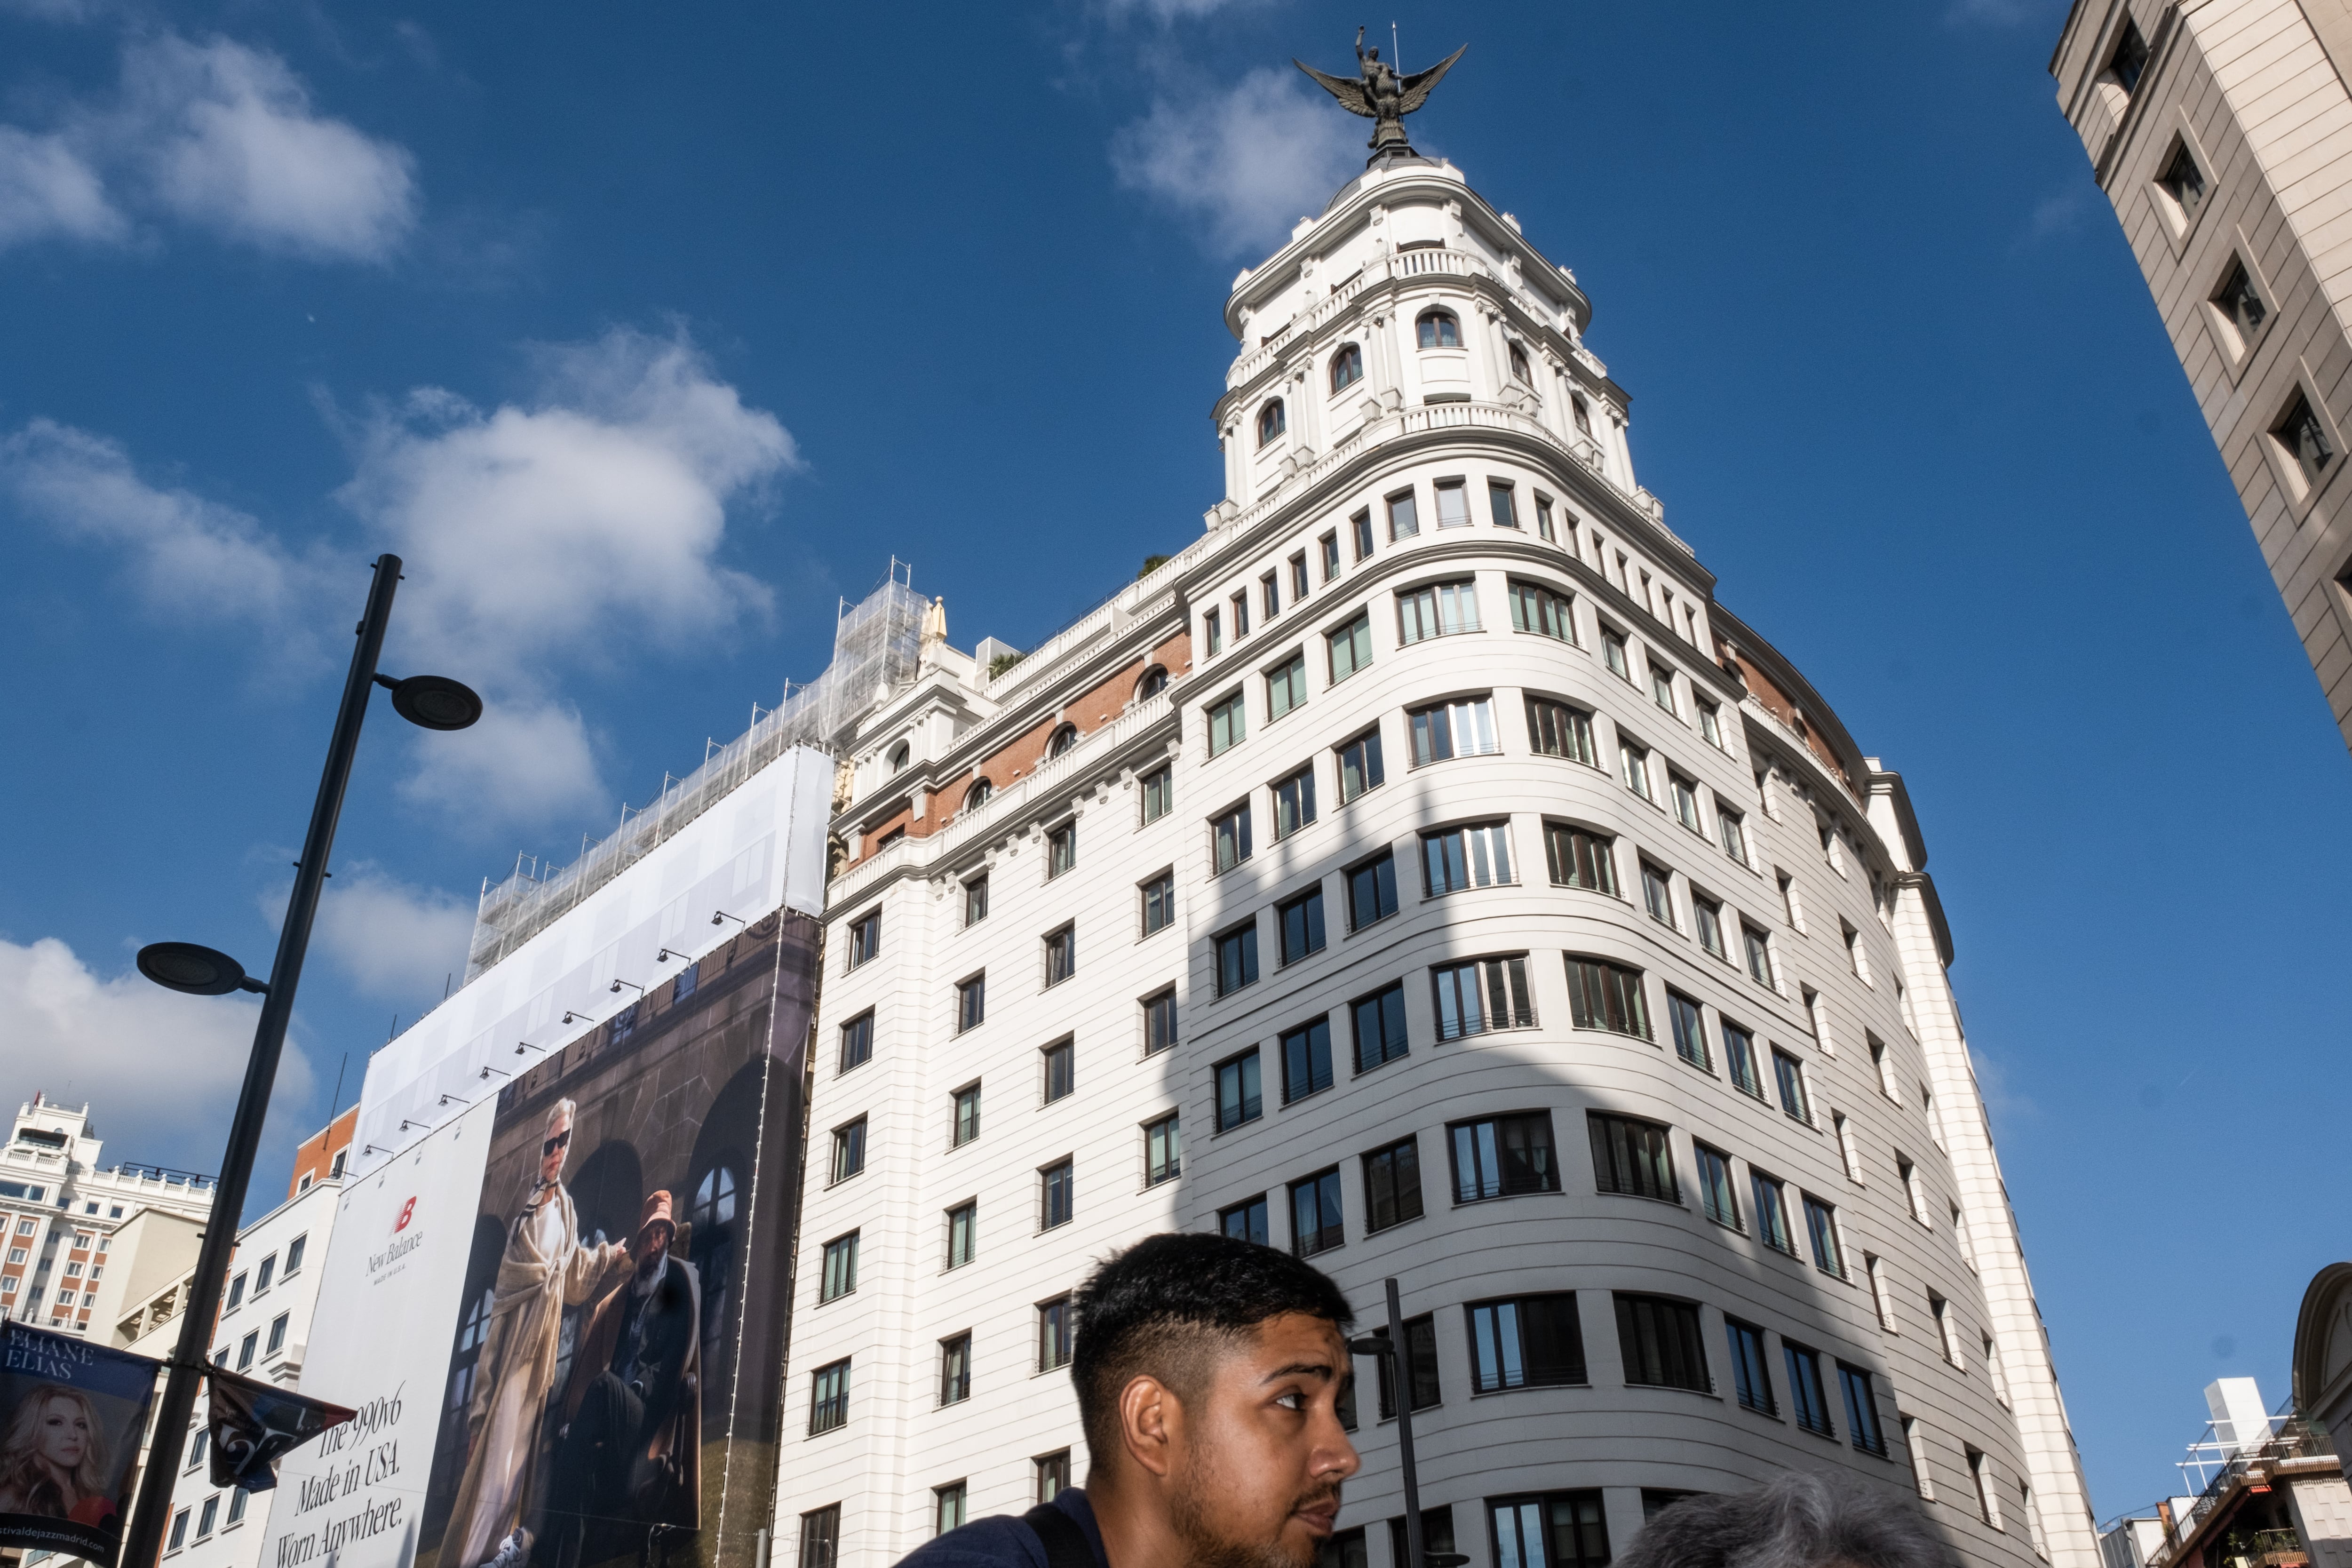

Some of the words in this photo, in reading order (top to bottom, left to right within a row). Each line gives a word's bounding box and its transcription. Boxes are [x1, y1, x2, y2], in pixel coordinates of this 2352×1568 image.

[366, 1253, 387, 1277] New
[386, 1231, 422, 1265] Balance
[5, 1349, 71, 1379] ELIAS
[10, 1329, 94, 1366] ELIANE
[348, 1379, 406, 1451] 990v6
[294, 1464, 340, 1517] Made
[342, 1459, 360, 1496] in
[365, 1438, 399, 1486] USA.
[277, 1532, 316, 1568] Worn
[316, 1496, 402, 1561] Anywhere.
